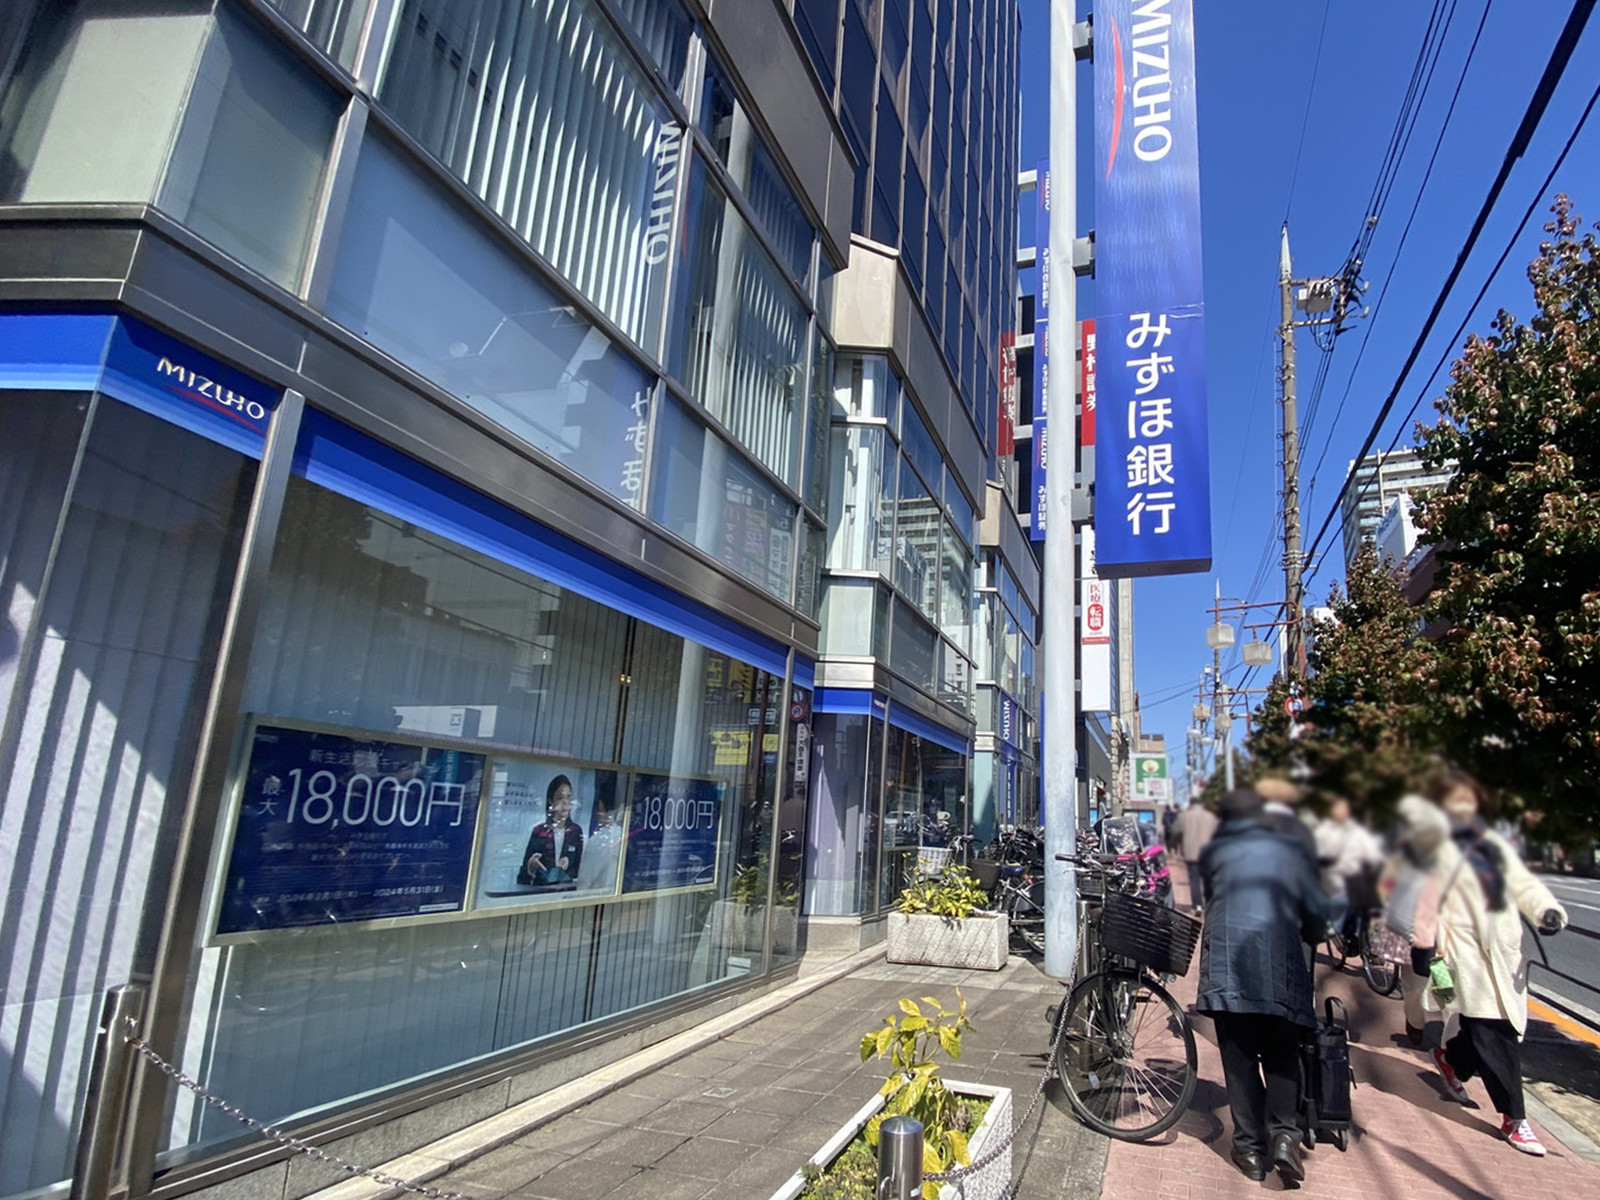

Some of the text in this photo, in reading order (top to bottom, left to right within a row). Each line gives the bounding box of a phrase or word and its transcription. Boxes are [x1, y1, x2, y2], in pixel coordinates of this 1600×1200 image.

[1132, 0, 1172, 162] MIZUHO
[157, 356, 265, 419] MIZUHO
[1126, 312, 1175, 536] みずほ銀行
[257, 775, 283, 817] 最大
[286, 768, 466, 830] 18,000円
[643, 796, 714, 832] 18,000円
